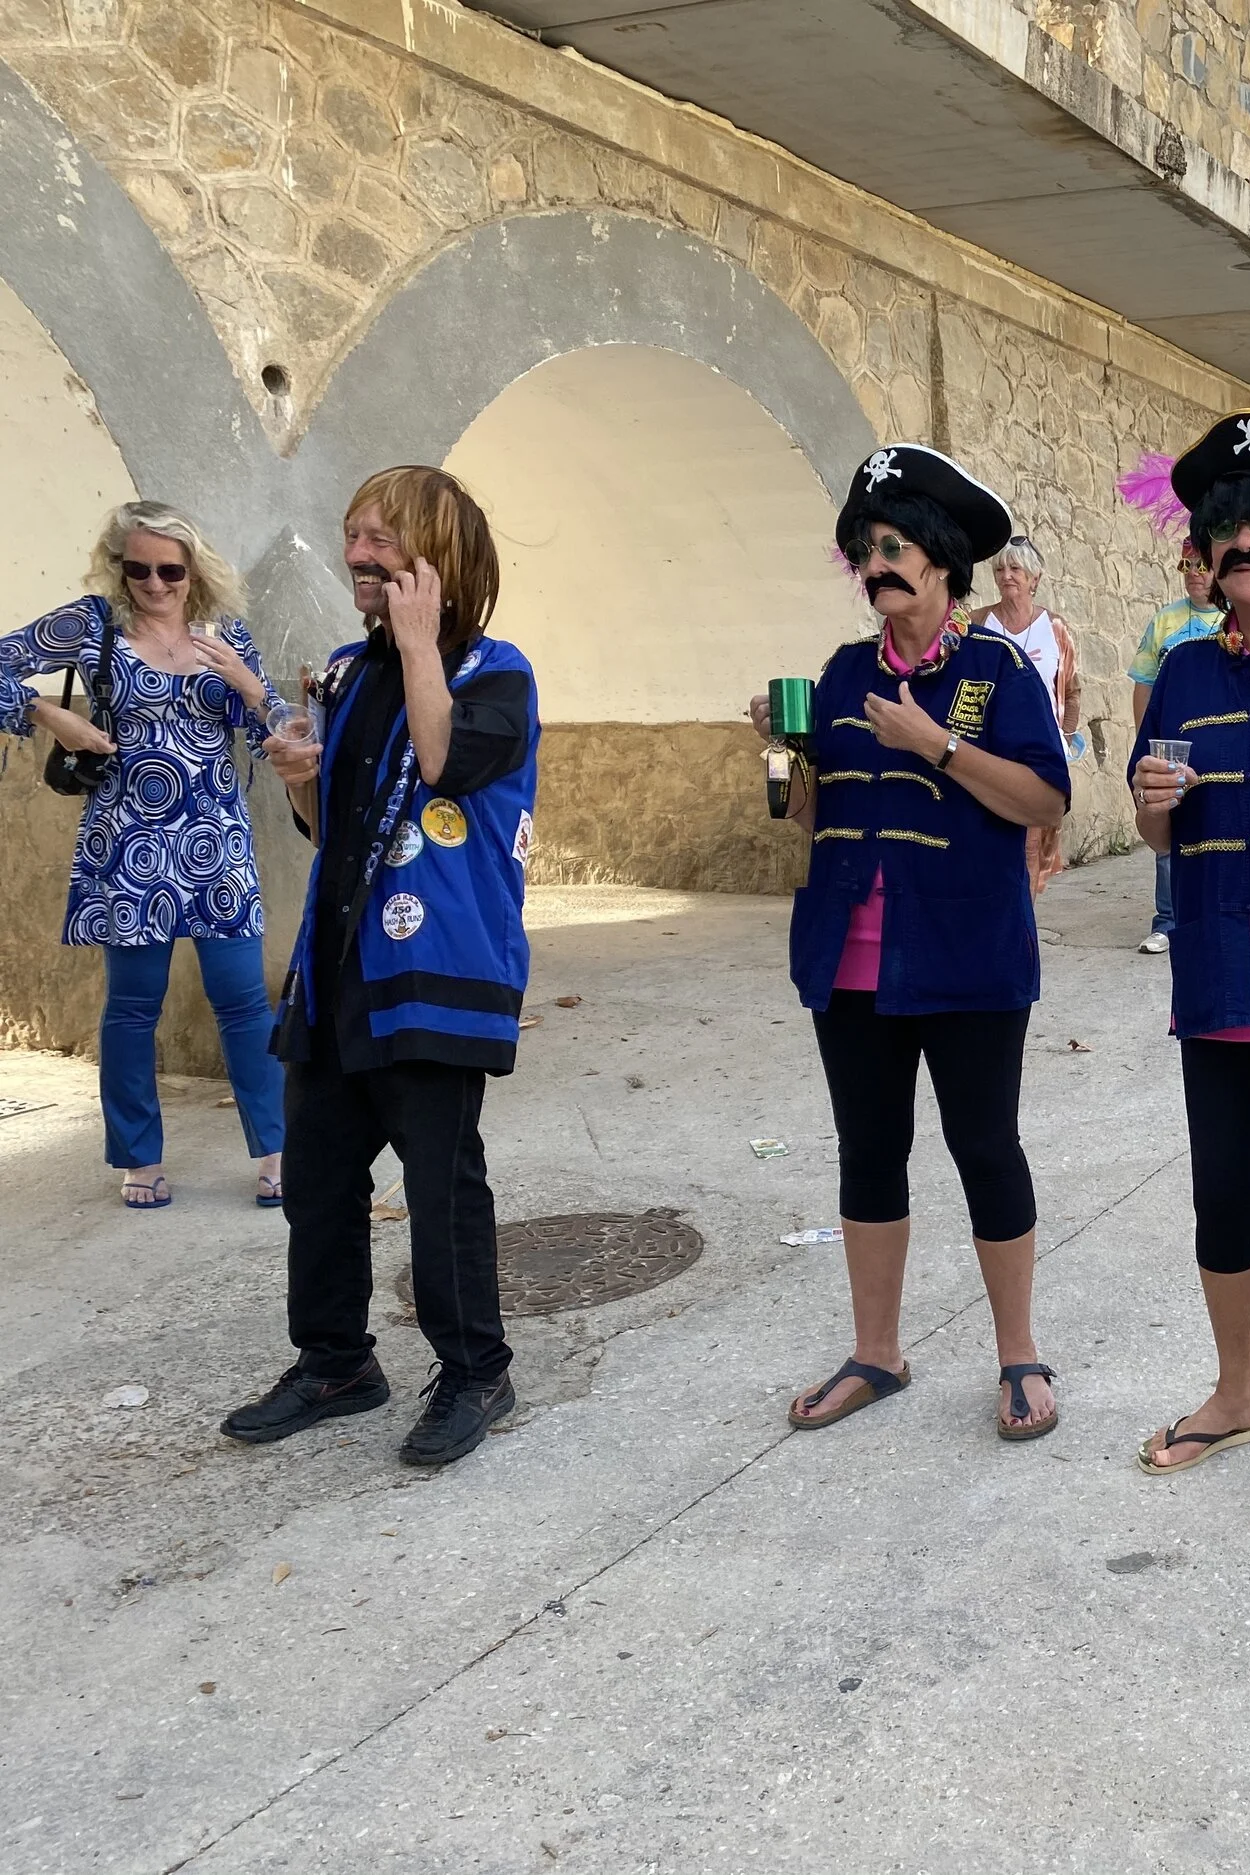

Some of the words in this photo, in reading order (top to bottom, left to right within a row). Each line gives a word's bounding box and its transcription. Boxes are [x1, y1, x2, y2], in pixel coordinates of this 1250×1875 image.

[957, 701, 979, 712] House
[392, 906, 412, 915] 450
[385, 918, 399, 926] HASH
[407, 914, 422, 922] RUNS
